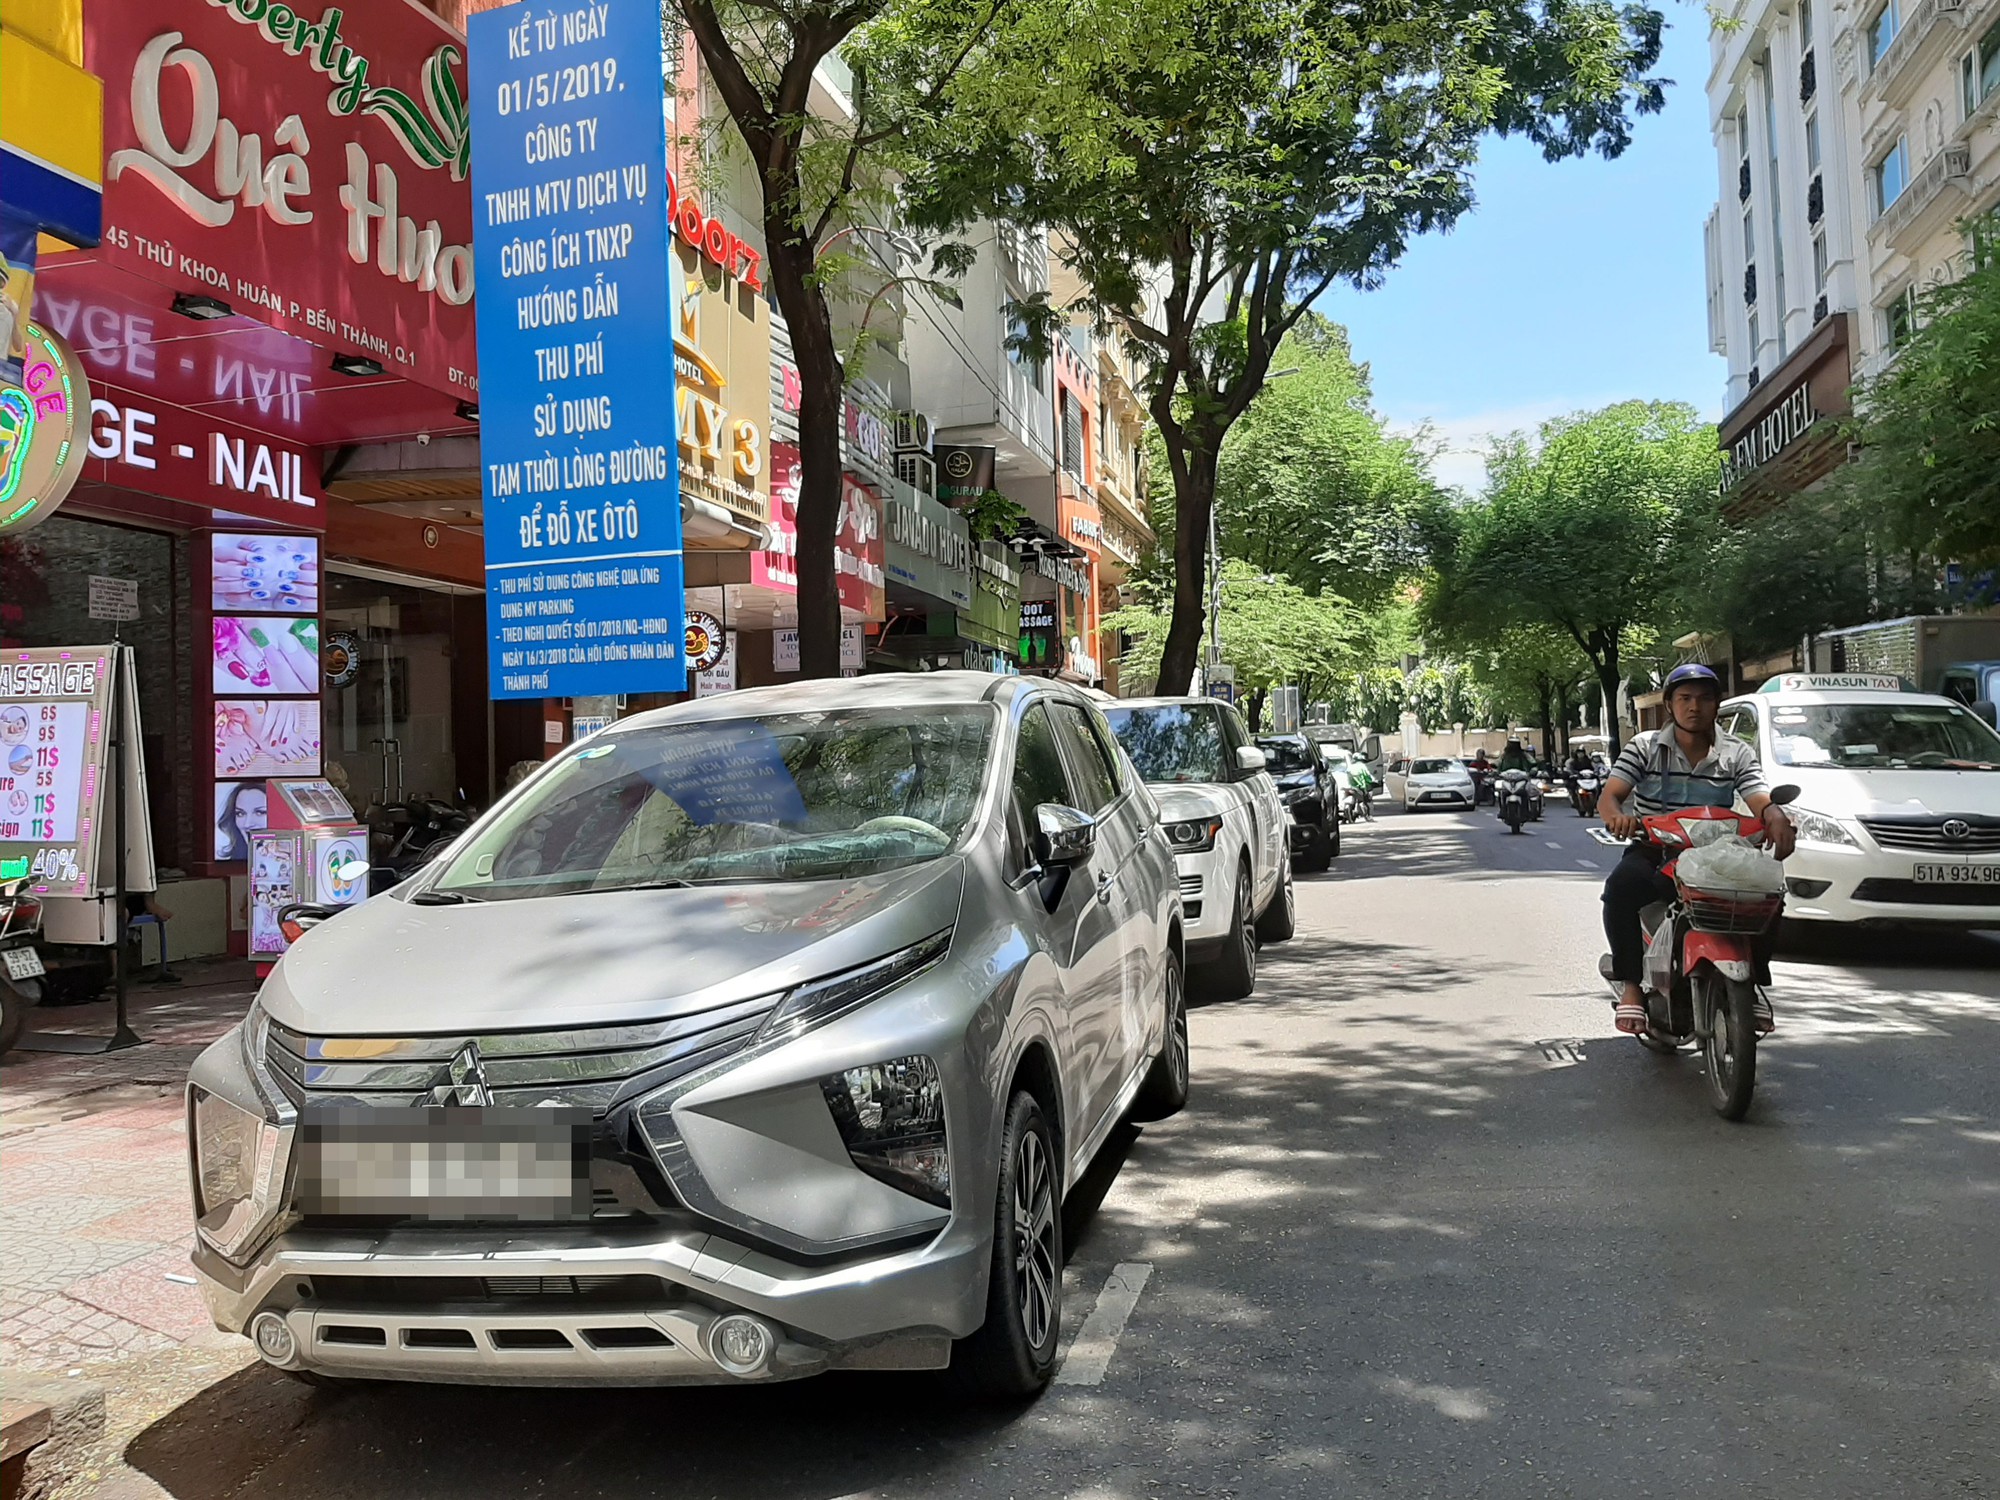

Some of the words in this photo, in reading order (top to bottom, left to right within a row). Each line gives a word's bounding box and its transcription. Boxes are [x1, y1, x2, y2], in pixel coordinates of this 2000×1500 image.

[508, 11, 530, 60] KỂ
[535, 9, 556, 51] TỪ
[563, 0, 609, 46] NGÀY
[107, 31, 313, 227] Quê
[526, 123, 571, 164] CÔNG
[577, 117, 598, 153] TY
[486, 187, 530, 226] TNHH
[535, 178, 571, 217] MTV
[577, 170, 617, 216] DỊCH
[623, 163, 647, 205] VỤ
[501, 238, 547, 279] CÔNG
[552, 228, 580, 270] ÍCH
[585, 223, 633, 265] TNXP
[106, 225, 129, 249] 45
[134, 236, 173, 267] THỦ
[180, 254, 230, 291] KHOA
[237, 278, 286, 318] HUÂN,
[290, 301, 302, 321] P.
[306, 308, 336, 334] BẾN
[341, 322, 391, 359] THÀNH,
[395, 346, 415, 366] Q.1
[518, 284, 577, 330] HƯỚNG
[583, 272, 619, 321] DẪN
[535, 346, 568, 382] THU
[575, 332, 603, 375] PHÍ
[674, 354, 704, 385] HOTEL
[534, 393, 556, 438] SỬ
[563, 395, 611, 439] DỤNG
[1761, 381, 1815, 463] HOTEL
[209, 432, 316, 507] NAIL
[489, 461, 520, 503] TẠM
[524, 452, 559, 493] THỜI
[564, 446, 605, 490] LÒNG
[609, 440, 666, 483] ĐƯỜNG
[735, 419, 761, 476] 3
[950, 486, 983, 497] SURAU
[519, 501, 542, 548] ĐỂ
[547, 500, 571, 546] ĐỖ
[576, 508, 597, 543] XE
[604, 499, 639, 540] ÔTÔ
[892, 501, 937, 559] JAVADO
[500, 578, 516, 595] THU
[518, 573, 532, 593] PHÍ
[547, 575, 569, 593] DỤNG
[571, 570, 594, 589] CÔNG
[597, 567, 619, 588] NGHỆ
[622, 568, 639, 586] QUA
[640, 565, 660, 585] ỨNG
[501, 602, 522, 621] DỤNG
[525, 601, 537, 617] MY
[539, 598, 574, 616] PARKING
[502, 627, 523, 643] THEO
[525, 625, 545, 644] NGHỊ
[546, 618, 572, 640] QUYẾT
[574, 618, 586, 638] SỐ
[502, 648, 524, 667] NGÀY
[526, 649, 567, 666] 16/3/2018
[569, 643, 586, 663] CỦA
[588, 644, 602, 665] HỘI
[604, 641, 628, 661] ĐỒNG
[630, 640, 654, 660] NHÂN
[656, 641, 675, 660] DÂN
[503, 672, 530, 692] THÀNH
[532, 669, 550, 690] PHỐ
[1809, 677, 1868, 687] VINASUN
[1870, 678, 1898, 688] TAXI
[31, 847, 79, 881] 40%
